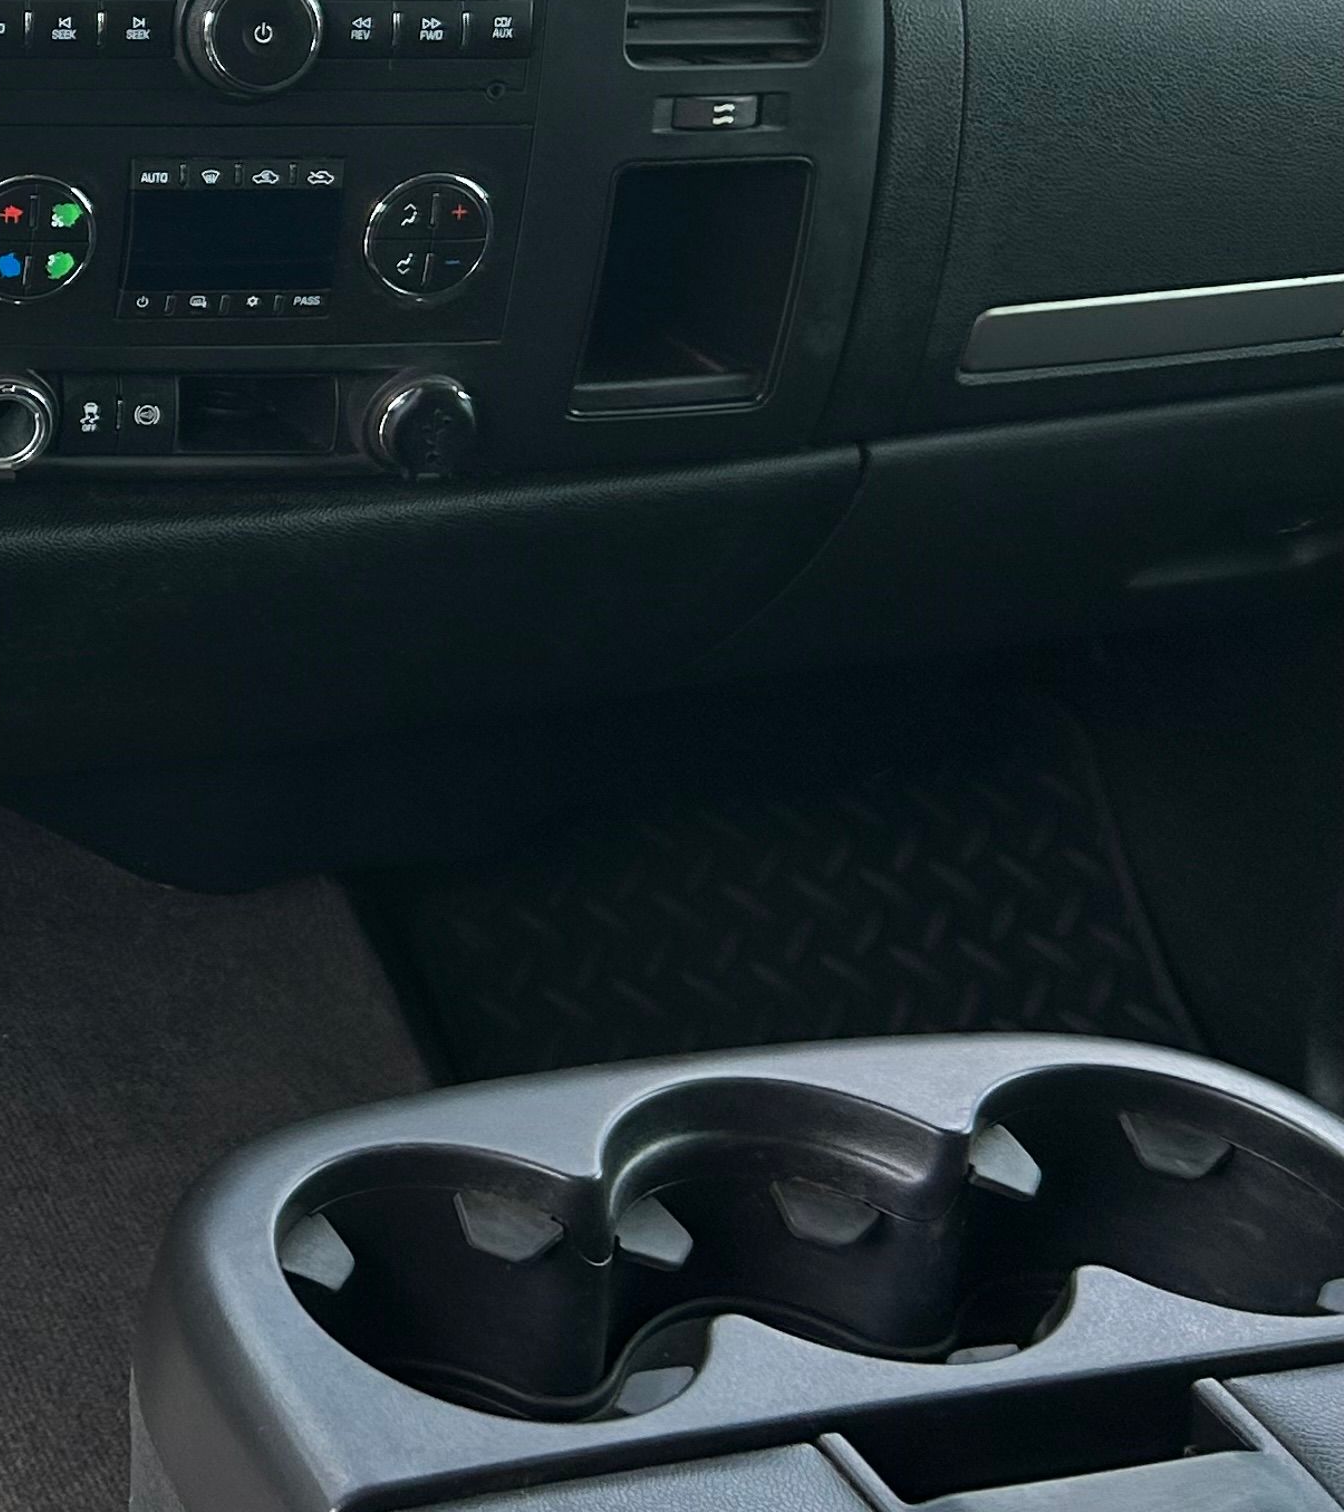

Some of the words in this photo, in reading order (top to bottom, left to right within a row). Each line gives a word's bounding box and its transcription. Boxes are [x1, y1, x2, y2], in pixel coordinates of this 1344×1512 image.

[51, 29, 77, 40] SEEK
[125, 29, 151, 40] SEEK
[351, 29, 371, 40] REV
[419, 29, 444, 40] FWD
[492, 27, 514, 39] AUX
[140, 172, 169, 184] AUTO
[292, 295, 321, 307] PASS
